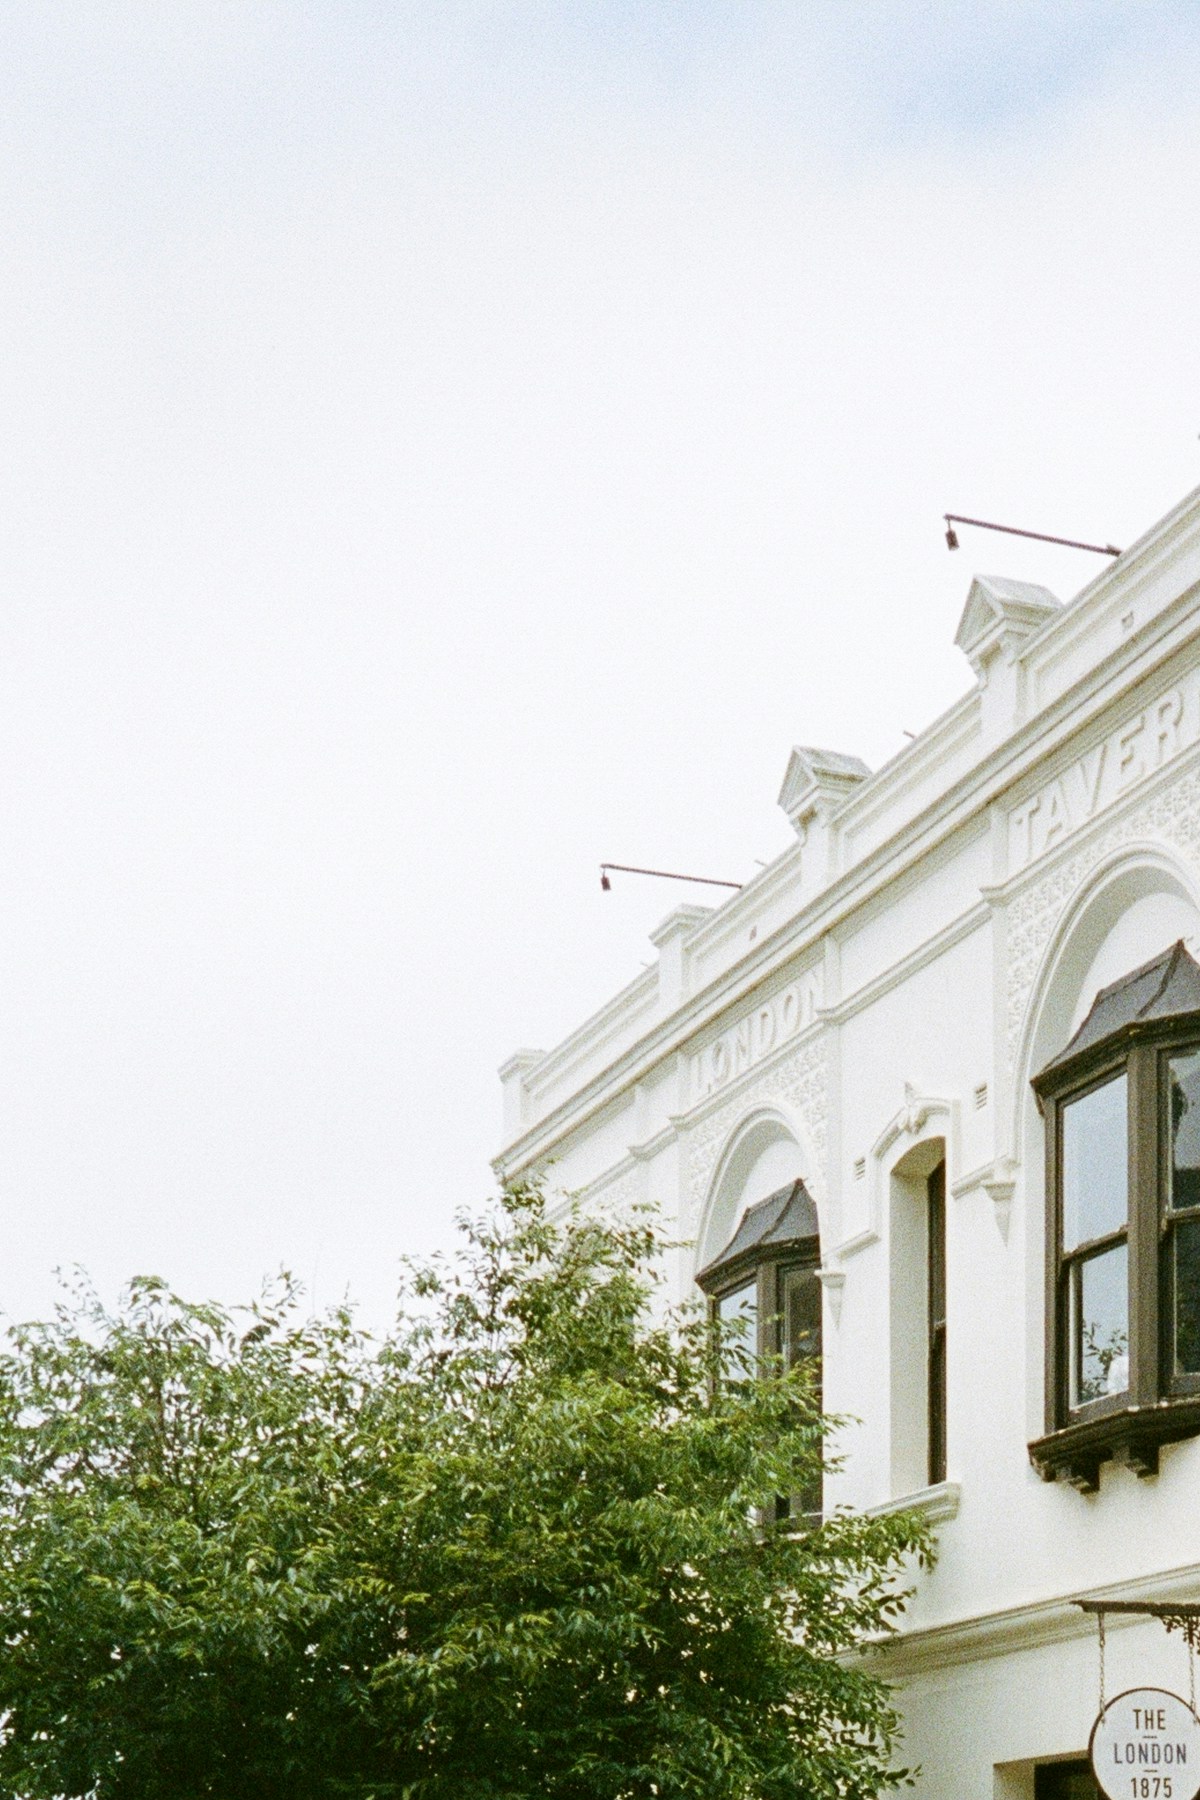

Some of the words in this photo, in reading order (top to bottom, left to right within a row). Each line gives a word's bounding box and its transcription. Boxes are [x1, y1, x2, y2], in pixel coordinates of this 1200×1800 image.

[1133, 1709, 1166, 1730] THE
[1113, 1743, 1187, 1764] LONDON
[1131, 1777, 1172, 1798] 1875
